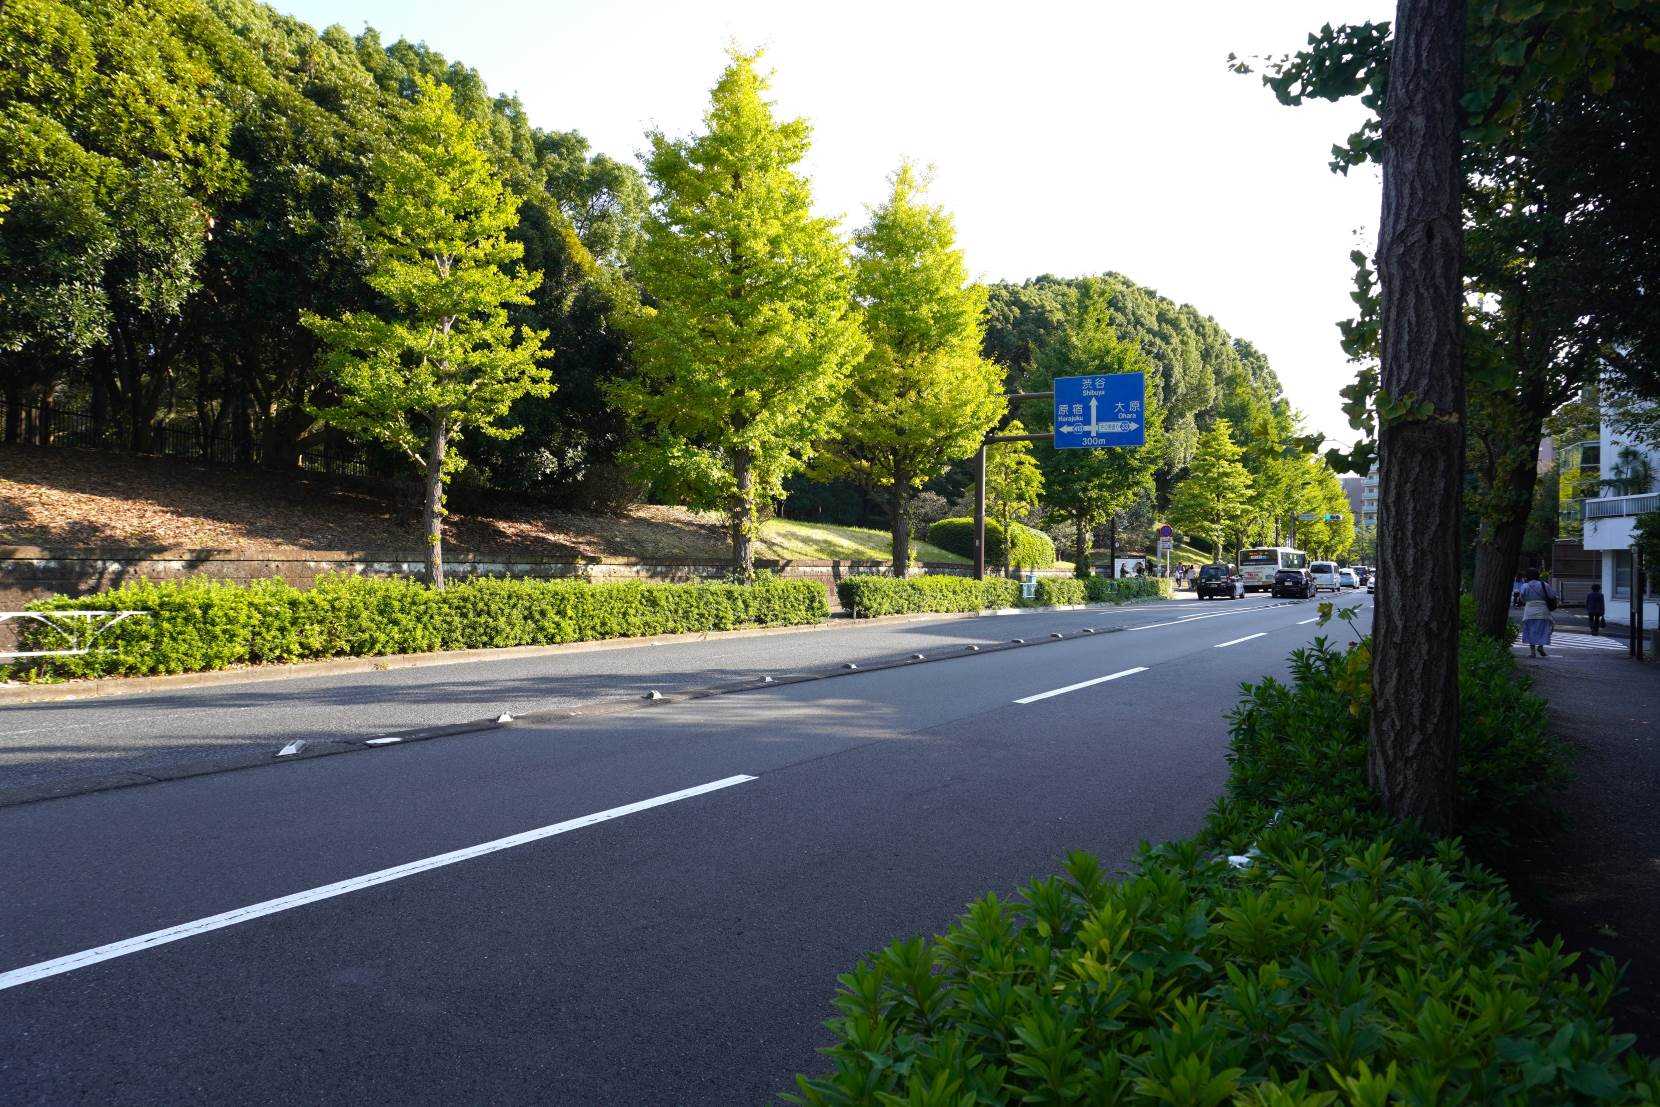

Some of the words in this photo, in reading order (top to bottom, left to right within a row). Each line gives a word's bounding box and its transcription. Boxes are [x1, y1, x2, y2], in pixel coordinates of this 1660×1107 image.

[1082, 378, 1106, 389] 渋谷
[1058, 404, 1083, 415] 原宿
[1114, 401, 1140, 413] 大原
[1082, 437, 1106, 446] 300m
